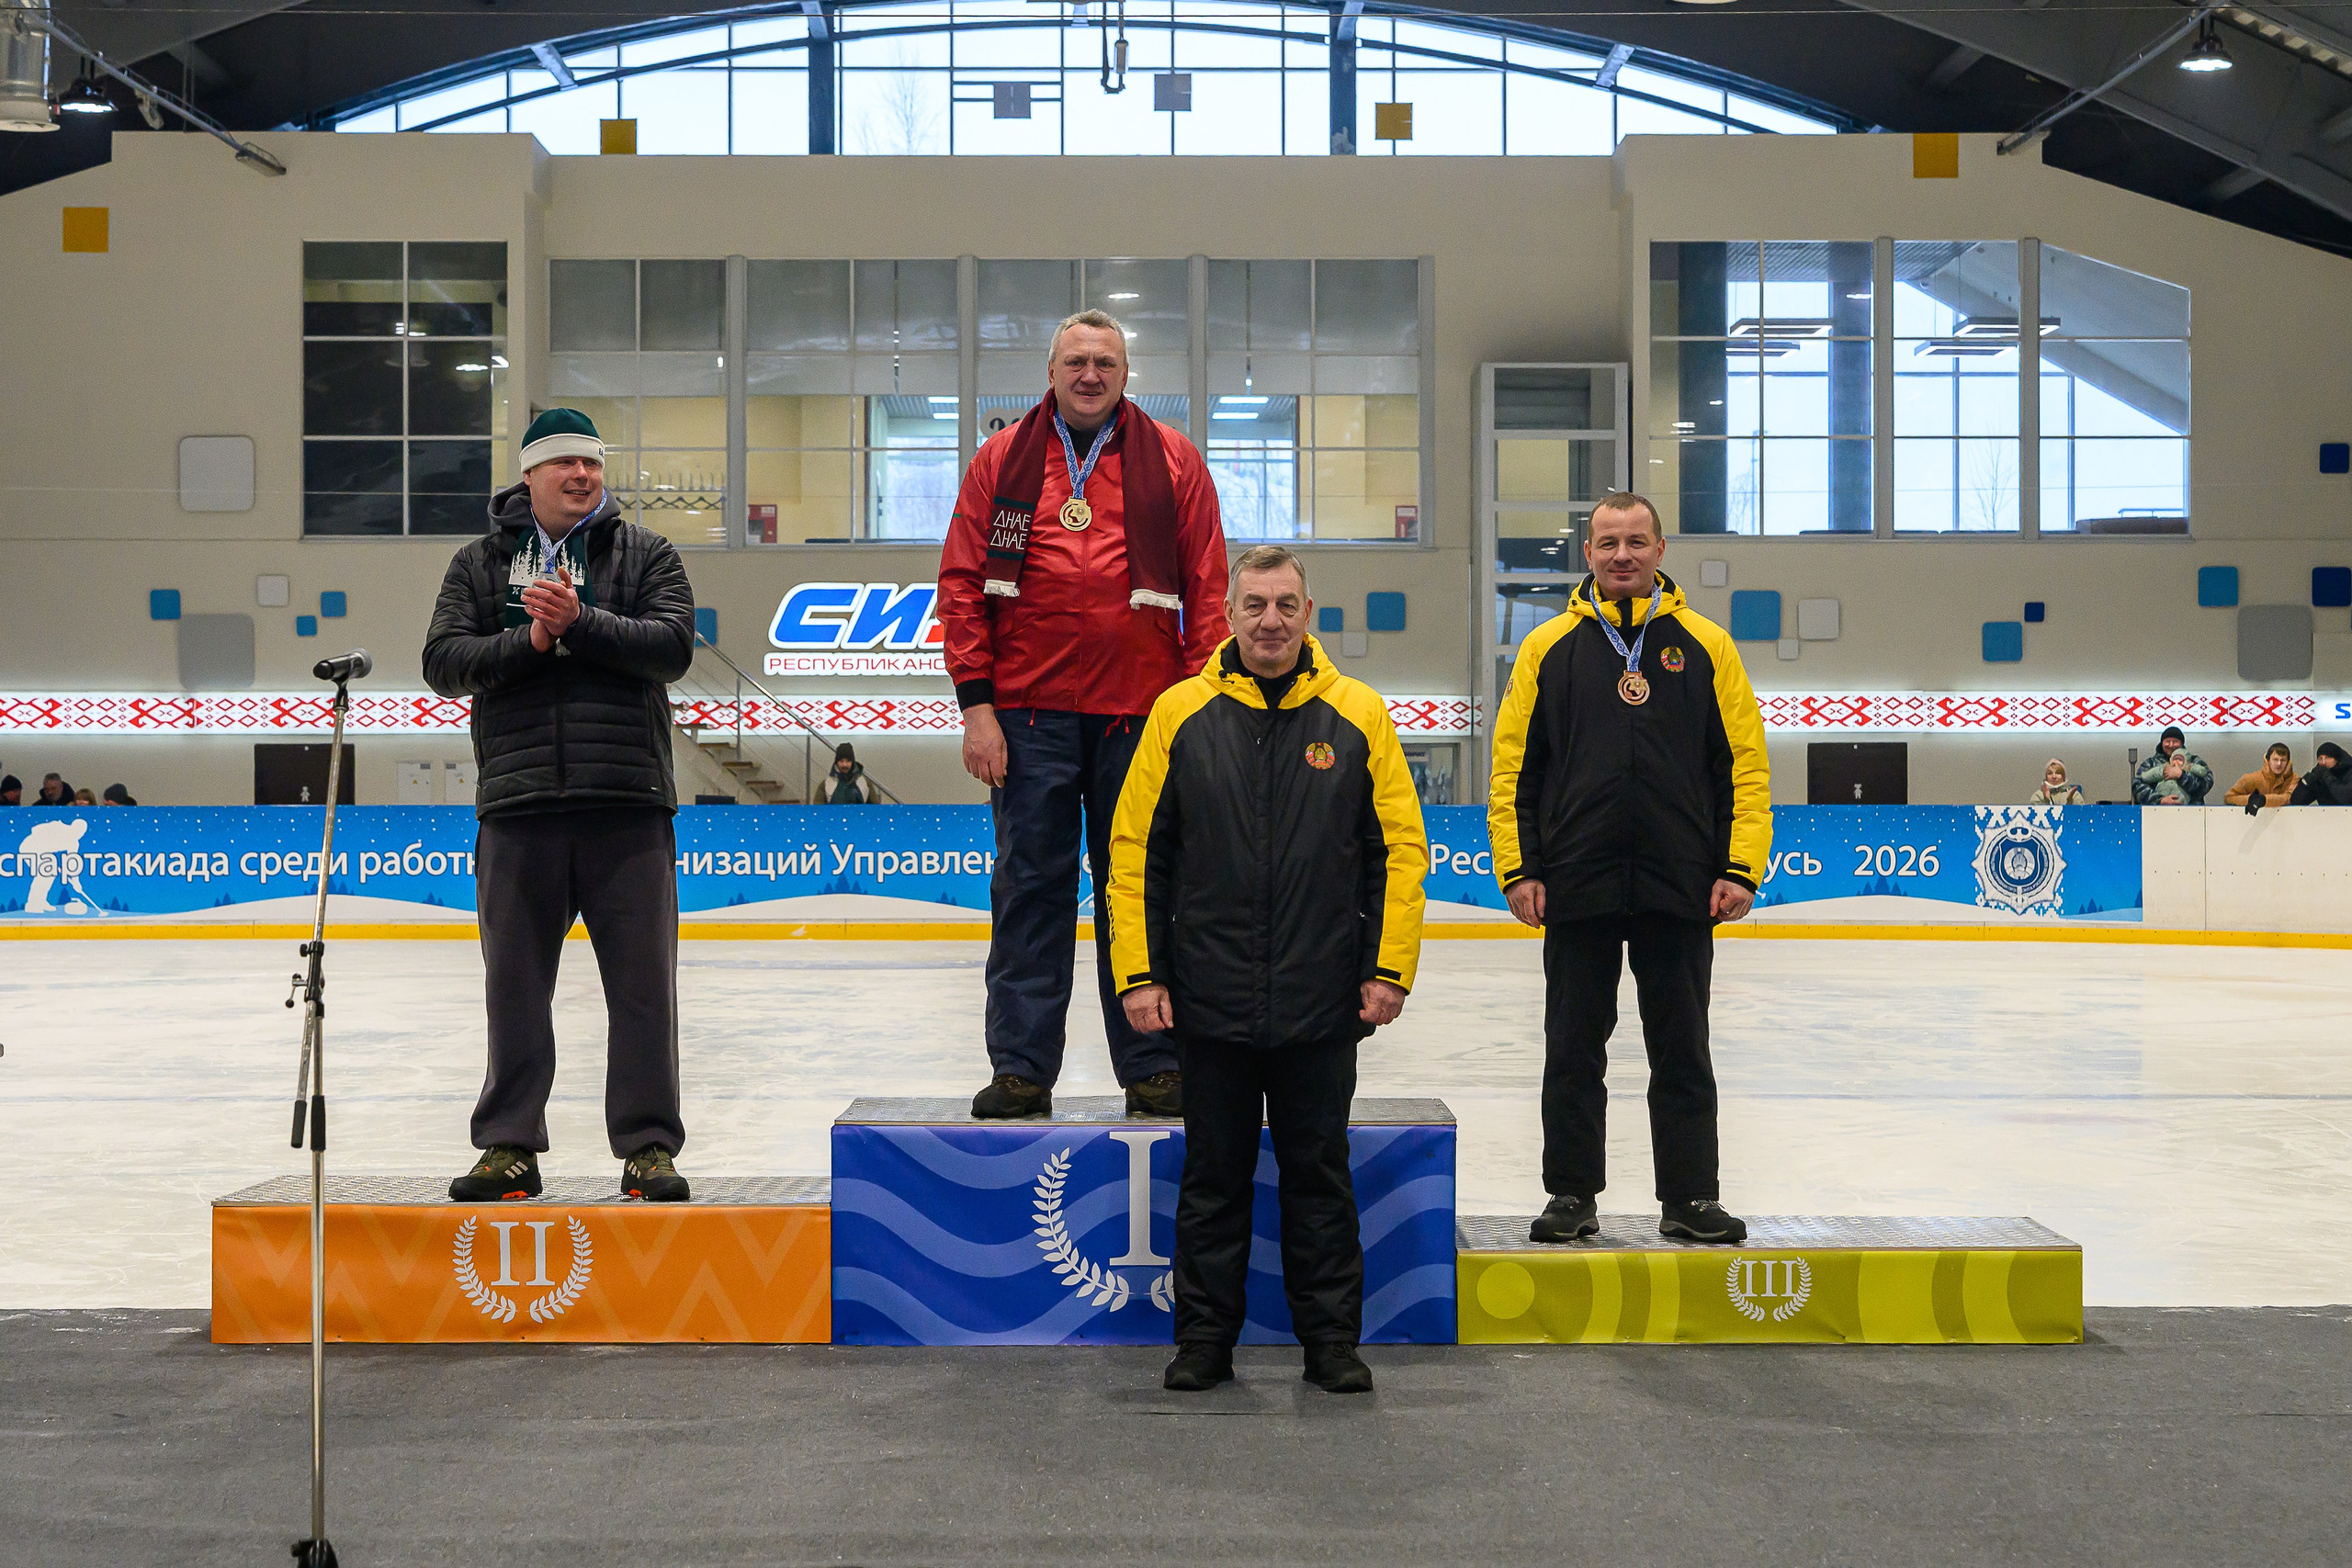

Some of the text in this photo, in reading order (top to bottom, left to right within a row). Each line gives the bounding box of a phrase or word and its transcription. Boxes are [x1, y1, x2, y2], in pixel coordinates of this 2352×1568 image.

[0, 852, 230, 884] спартакиада
[239, 851, 348, 884] среди
[1430, 843, 1496, 875] Рес
[1854, 844, 1940, 877] 2026
[1109, 1131, 1170, 1266] I
[490, 1221, 556, 1286] II
[1741, 1260, 1798, 1297] III
